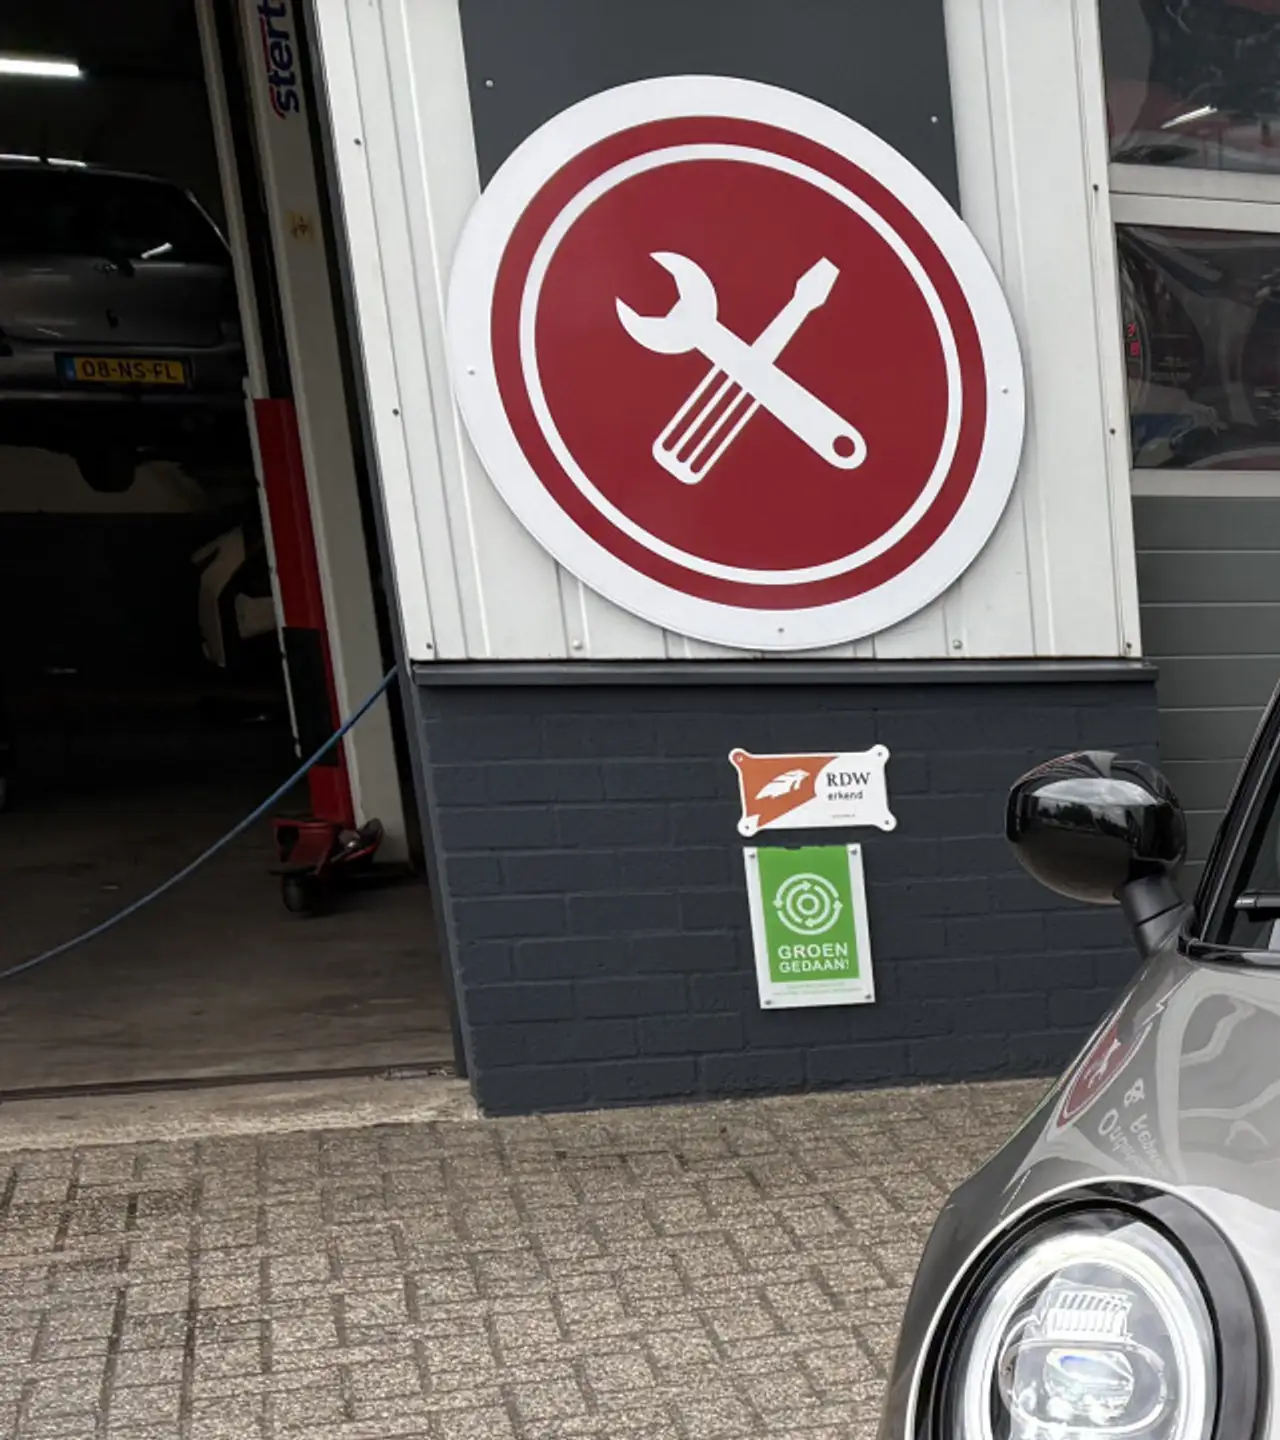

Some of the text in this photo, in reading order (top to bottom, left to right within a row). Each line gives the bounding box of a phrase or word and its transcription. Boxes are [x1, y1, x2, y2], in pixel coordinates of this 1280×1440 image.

[826, 771, 871, 787] RDW
[827, 790, 863, 801] erkend
[778, 942, 848, 959] GROEN
[779, 958, 849, 973] GEDAAN!
